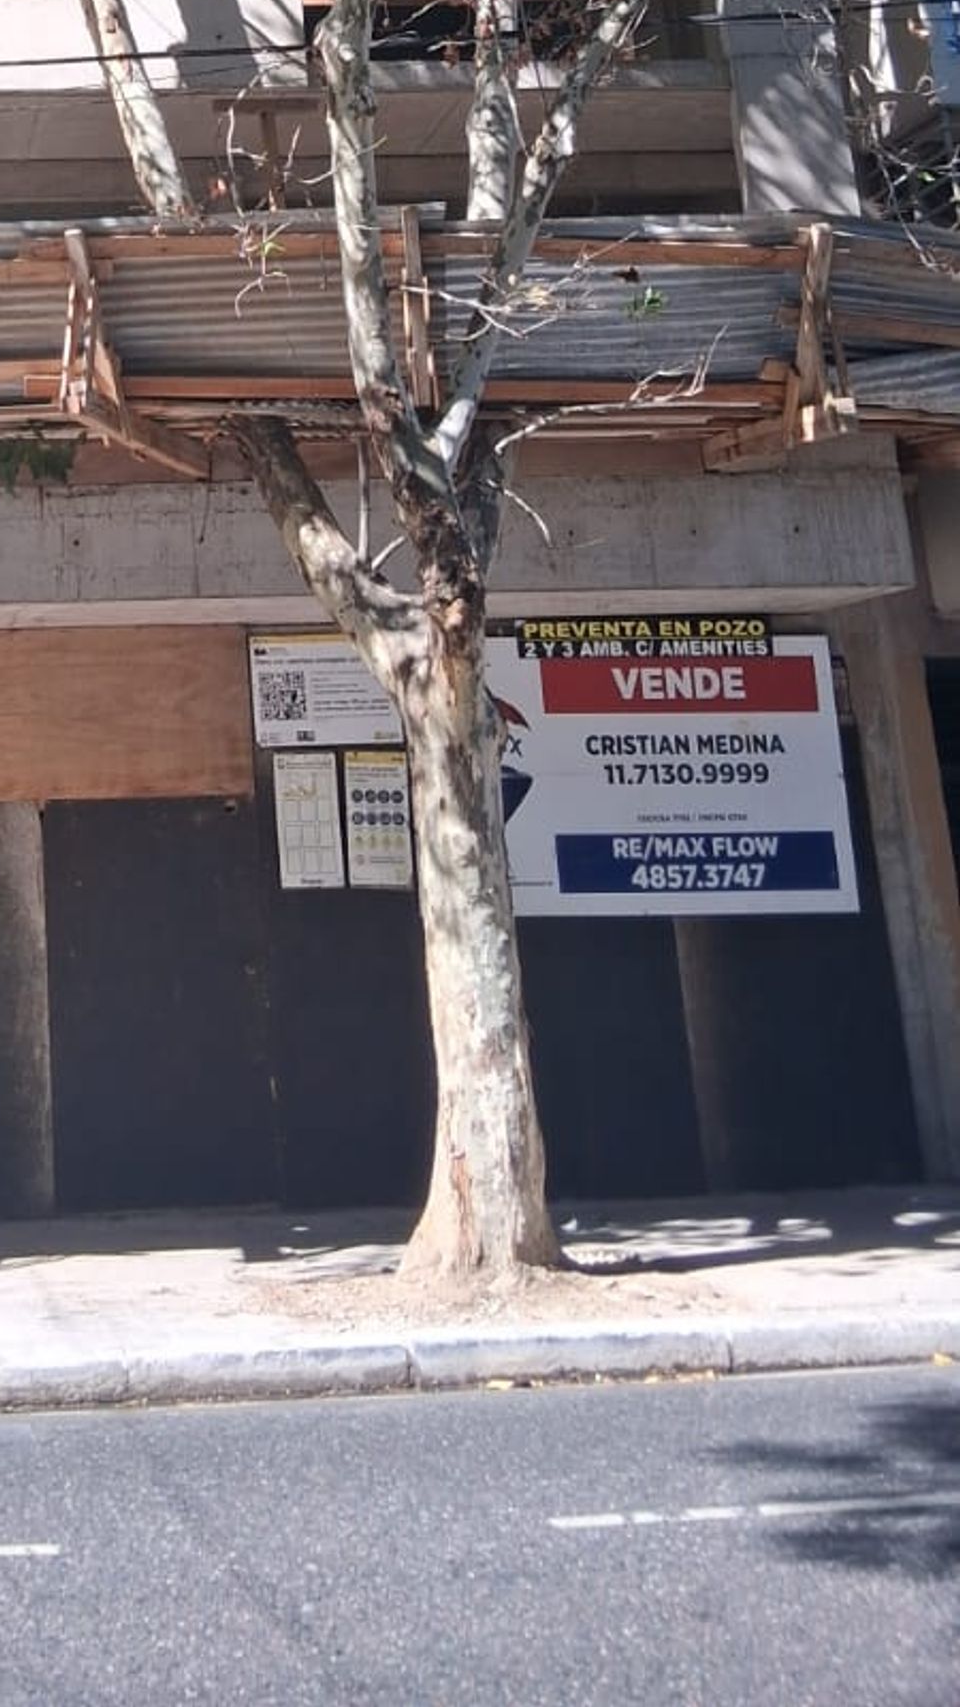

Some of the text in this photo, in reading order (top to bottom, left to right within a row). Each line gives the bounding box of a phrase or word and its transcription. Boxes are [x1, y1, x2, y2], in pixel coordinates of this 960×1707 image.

[523, 620, 765, 639] PREVENTA EN POZO
[524, 639, 768, 657] 2 Y 3 AMB. C/ AMENITIES
[612, 666, 747, 700] VENDE
[585, 734, 786, 755] CRISTIAN MEDINA
[603, 762, 770, 785] 11.7130.9999
[612, 835, 779, 860] RE/MAX FLOW
[631, 863, 765, 889] 4857.3747
